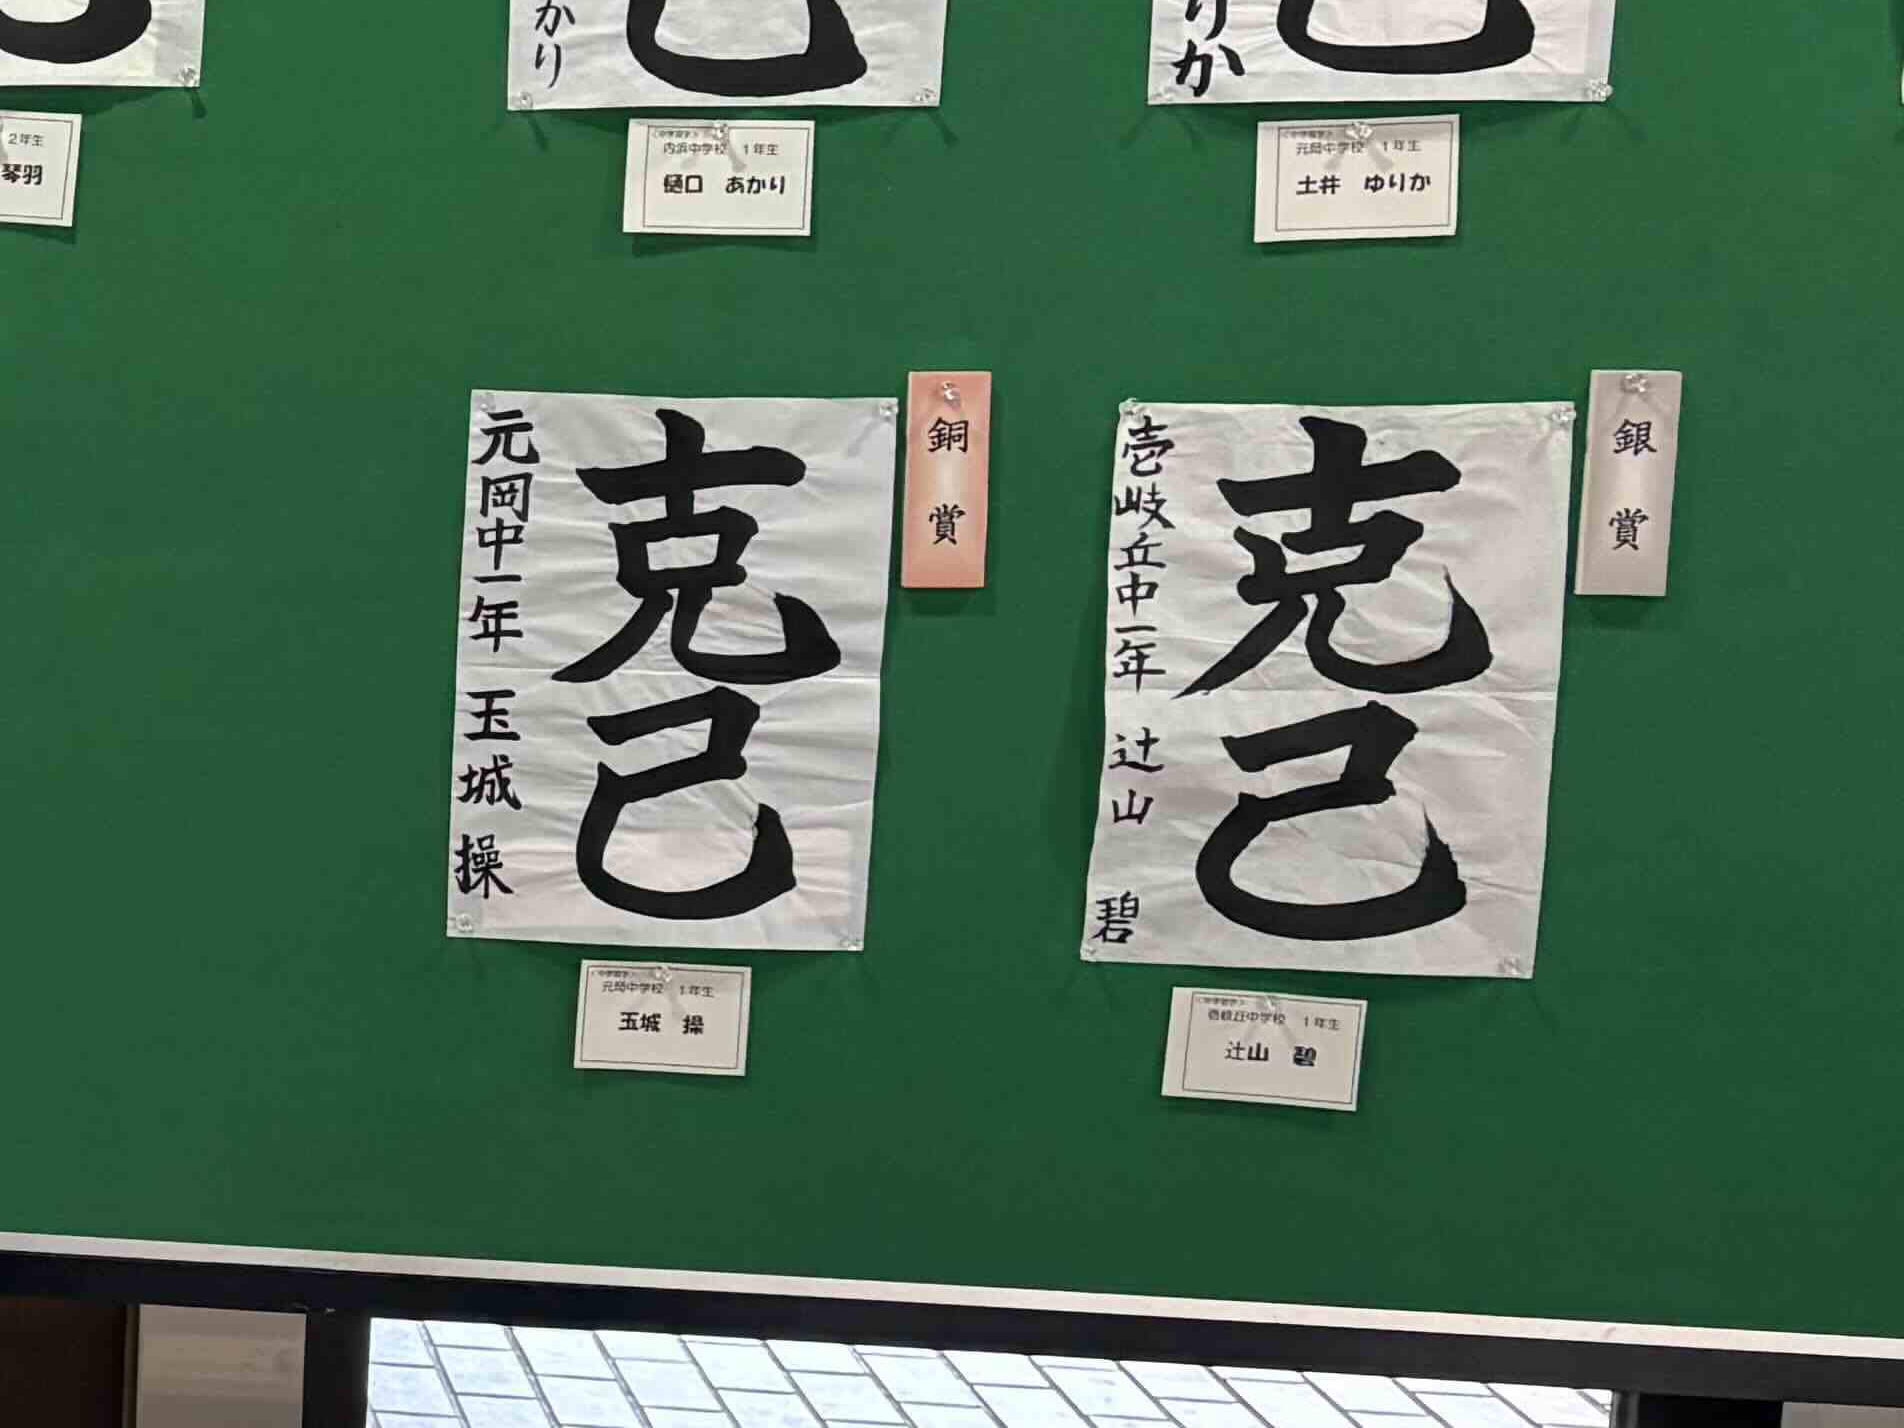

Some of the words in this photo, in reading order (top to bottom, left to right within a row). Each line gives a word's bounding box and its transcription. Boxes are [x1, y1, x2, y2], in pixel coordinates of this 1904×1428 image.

[1, 164, 43, 185] 琴羽
[725, 175, 786, 195] あかり
[1296, 175, 1341, 195] 土井
[1364, 172, 1432, 193] ゆりか
[926, 416, 968, 547] 銅賞
[1608, 418, 1657, 551] 銀賞
[550, 408, 841, 920] 克己
[1171, 416, 1493, 942] 克己
[619, 1012, 662, 1032] 玉城
[682, 1014, 705, 1035] 操
[1224, 1041, 1270, 1063] 辻山
